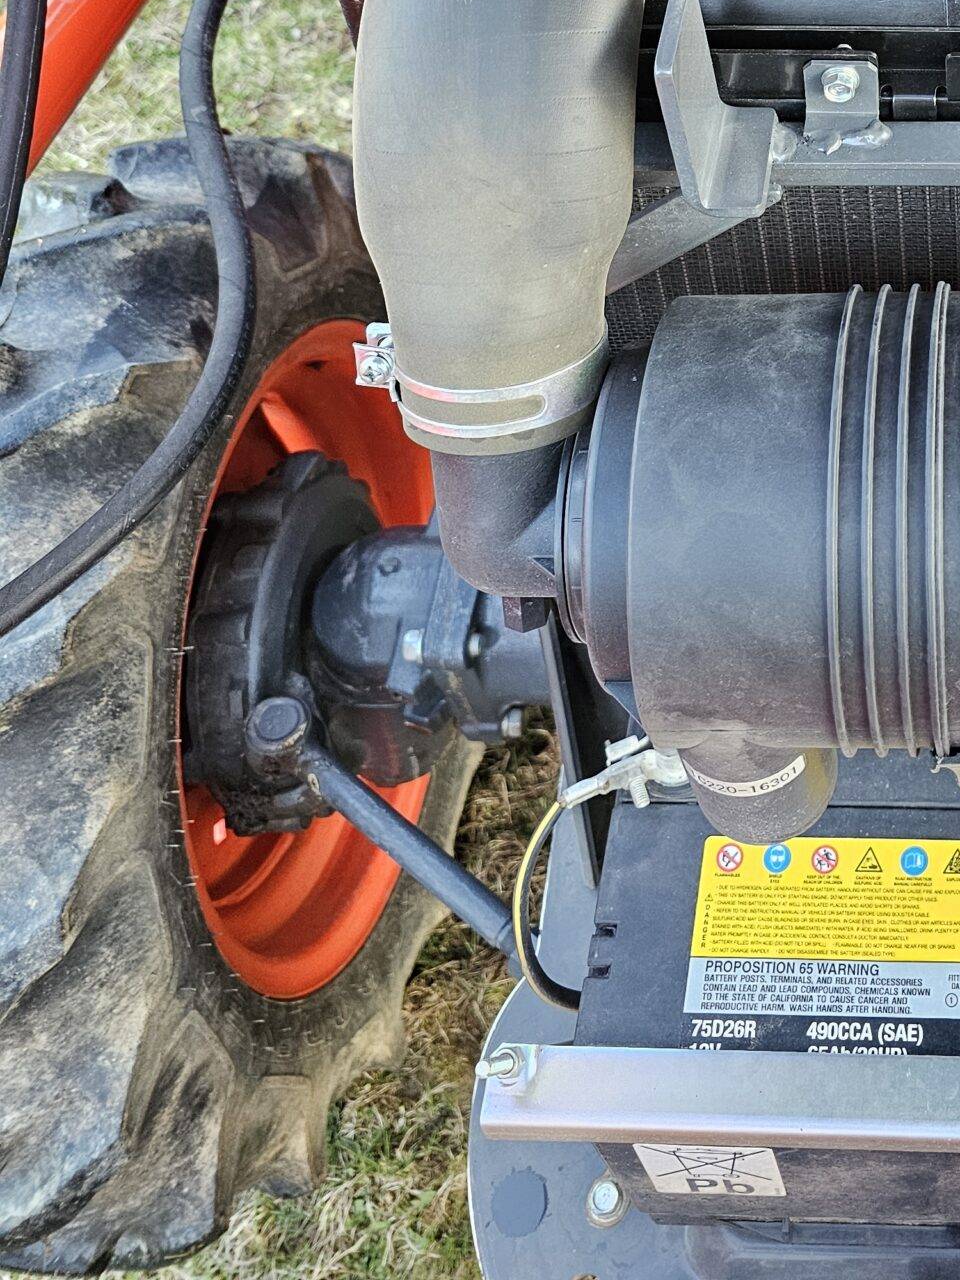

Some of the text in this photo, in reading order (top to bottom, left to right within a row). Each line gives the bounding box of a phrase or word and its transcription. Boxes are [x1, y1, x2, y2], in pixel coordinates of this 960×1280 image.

[705, 959, 879, 976] PROPOSITION 65 WARNING
[704, 974, 737, 982] BATTERY
[834, 977, 867, 985] RELATED
[870, 978, 922, 986] ACCESSORIES
[703, 983, 736, 994] CONTAIN
[738, 984, 757, 994] LEAD
[760, 985, 776, 994] AND
[778, 985, 797, 993] LEAD
[854, 985, 898, 995] CHEMICALS
[901, 988, 930, 996] KNOWN
[702, 992, 907, 1005] TO THE STATE OF CALIFORNIA TO CAUSE CANCER AND
[700, 1002, 757, 1011] REPRODUCTIVE
[789, 1004, 813, 1012] WASH
[845, 1005, 869, 1013] AFTER
[691, 1020, 757, 1038] 75D26R
[806, 1022, 873, 1041] 490CCA
[878, 1023, 924, 1046] (SAE)
[686, 1178, 755, 1194] Pb
